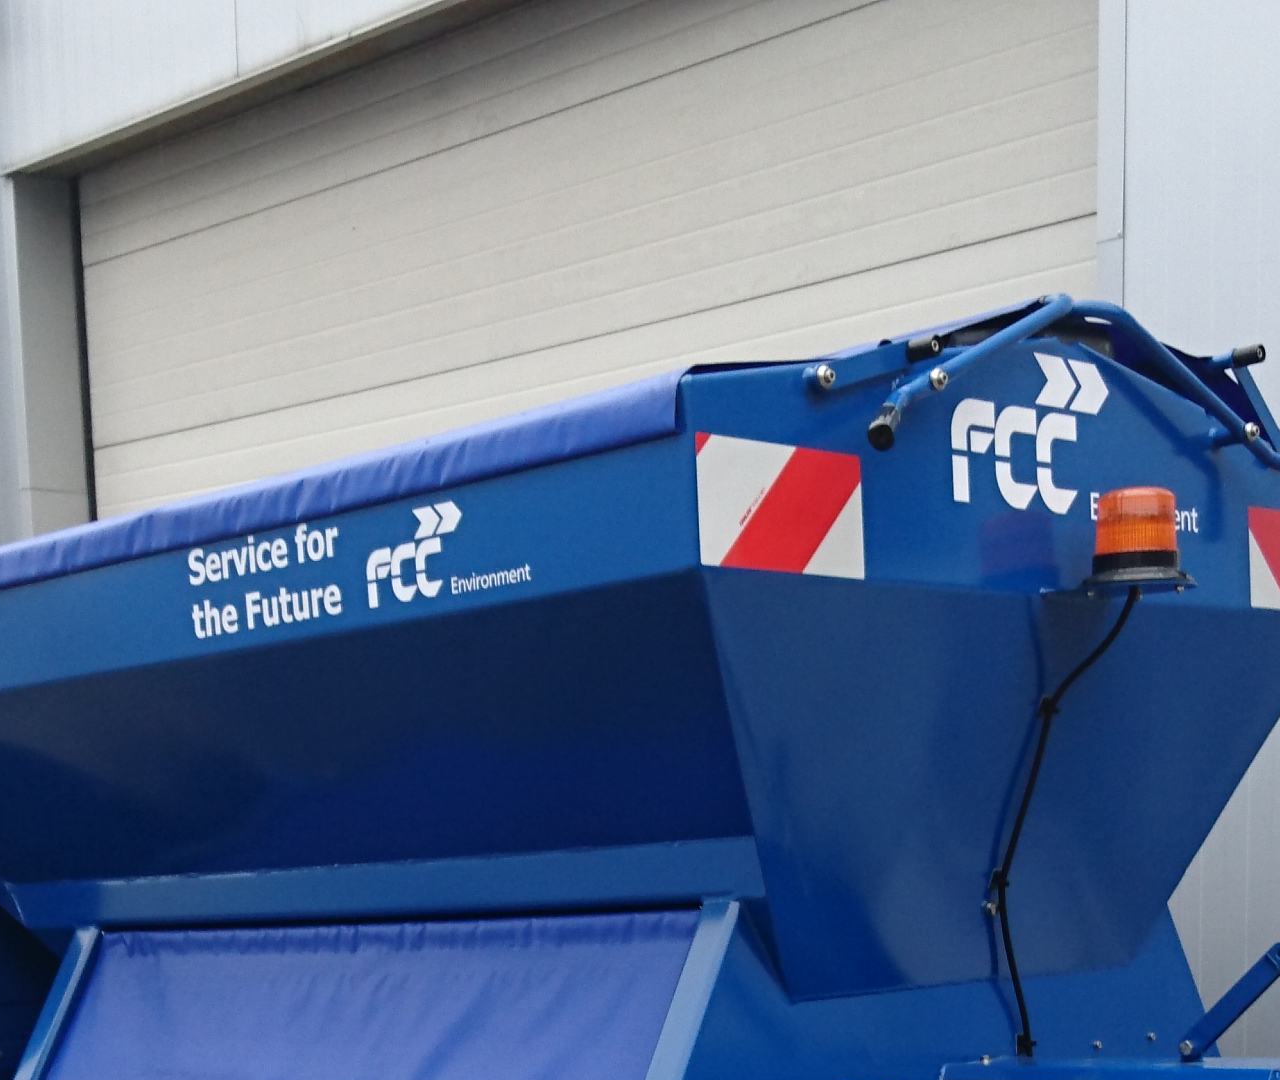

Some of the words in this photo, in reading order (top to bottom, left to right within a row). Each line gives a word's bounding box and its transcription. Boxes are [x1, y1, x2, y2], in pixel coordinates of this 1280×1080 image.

[950, 397, 1078, 516] FCC
[187, 534, 289, 587] Service
[294, 522, 339, 564] for
[365, 535, 444, 610] FCC
[450, 562, 532, 596] Environment
[191, 599, 239, 640] the
[245, 583, 343, 631] Future
